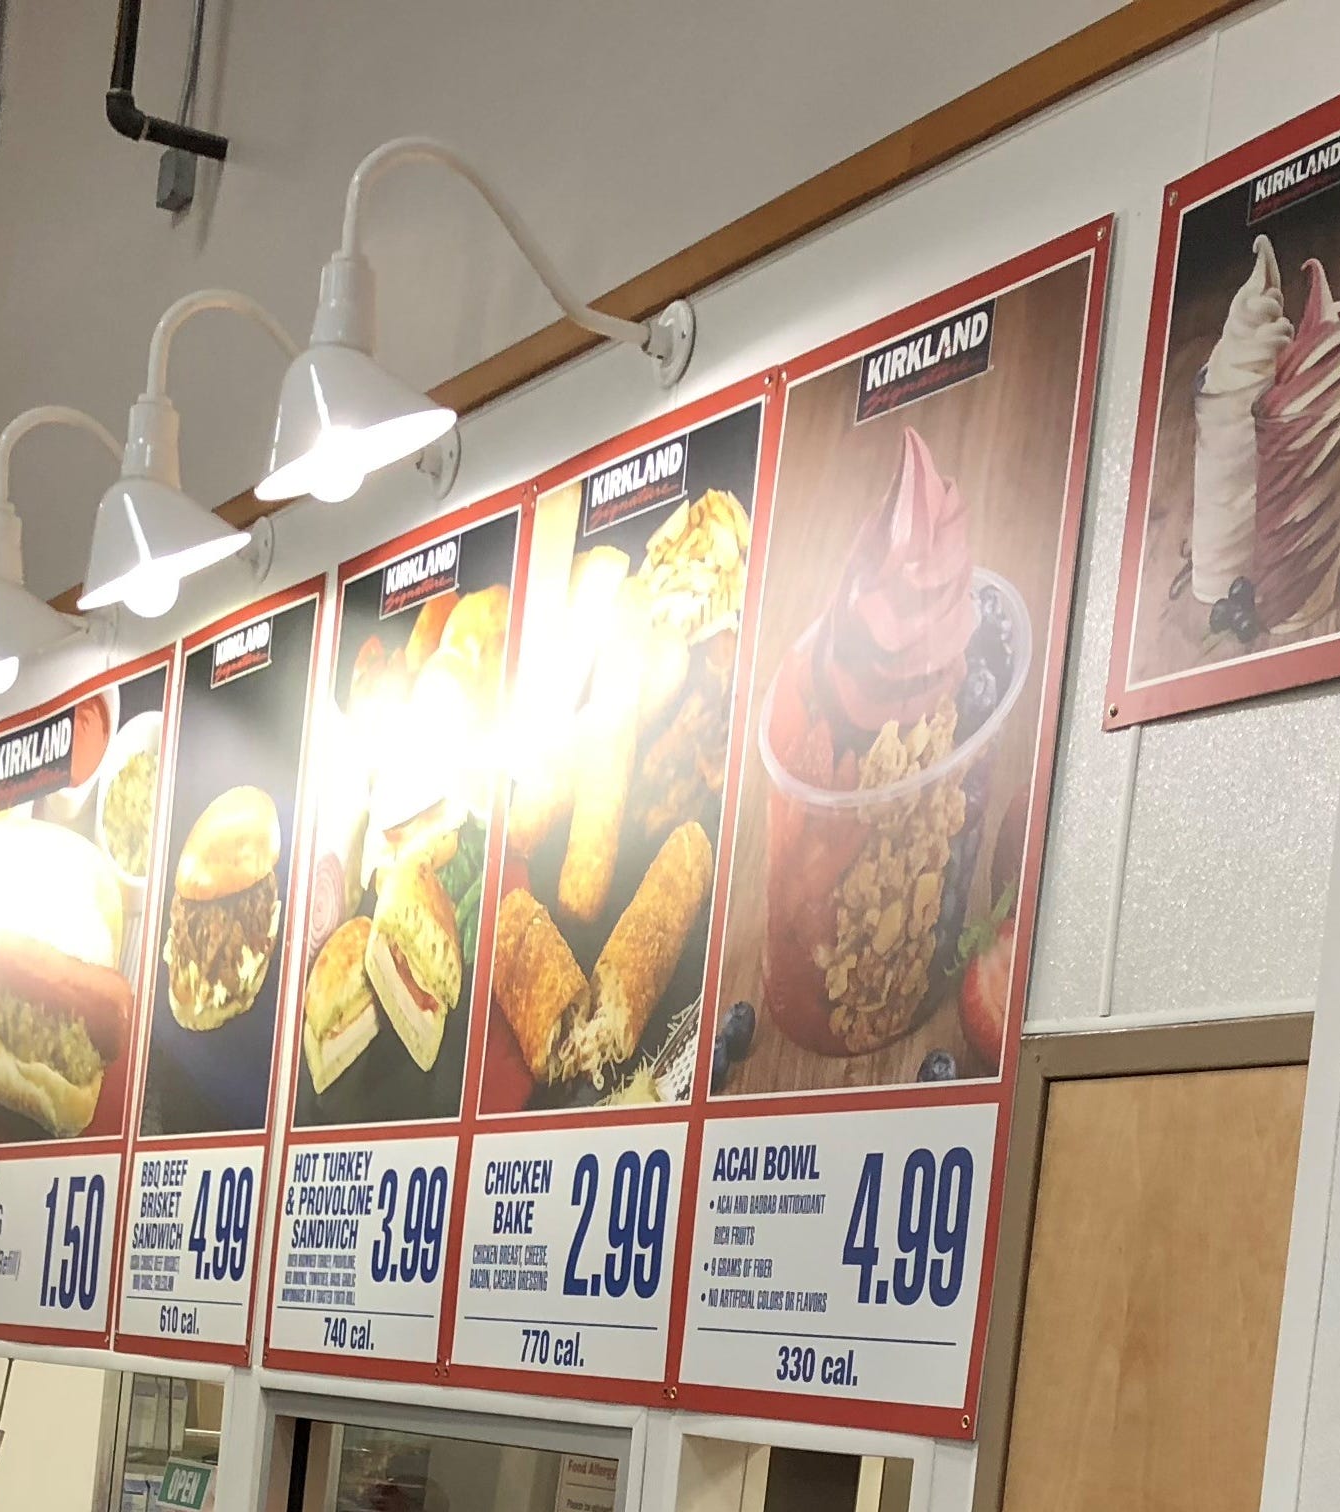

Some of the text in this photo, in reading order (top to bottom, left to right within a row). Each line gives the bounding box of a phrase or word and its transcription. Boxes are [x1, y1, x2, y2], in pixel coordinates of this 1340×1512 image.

[866, 311, 989, 392] KIRKLAND
[591, 442, 683, 508] KIRKLAND
[385, 541, 457, 595] KIRKLAND
[215, 621, 271, 667] KIRKLAND
[141, 1159, 189, 1189] BBQ BEEF
[293, 1151, 373, 1183] HOT TURKEY
[484, 1159, 553, 1195] CHICKEN
[712, 1144, 820, 1182] ACAI BOWL
[140, 1191, 182, 1218] BRISKET
[285, 1185, 374, 1216] & PROVOLONE
[492, 1200, 535, 1235] BAKE
[716, 1195, 733, 1215] ACAI
[733, 1195, 749, 1215] AND
[132, 1222, 184, 1250] SANDWICH
[188, 1166, 254, 1282] 4.99
[291, 1219, 359, 1250] SANDWICH
[371, 1166, 448, 1284] 3.99
[562, 1149, 671, 1299] 2.99
[730, 1226, 755, 1246] FRUITS
[842, 1146, 974, 1307] 4.99
[40, 1174, 105, 1311] 1.50
[710, 1258, 717, 1277] 9
[717, 1258, 741, 1278] GRAMS
[742, 1258, 753, 1278] OF
[708, 1288, 720, 1308] NO
[719, 1289, 755, 1310] ARTIFICIAL
[795, 1292, 828, 1313] FLAVORS
[160, 1305, 200, 1335] 610 cal.
[323, 1317, 375, 1350] 740 cal.
[520, 1329, 584, 1367] 770 cal.
[776, 1345, 858, 1386] 330 cal.
[167, 1467, 201, 1505] OPEN
[567, 1459, 618, 1480] Food Allergy
